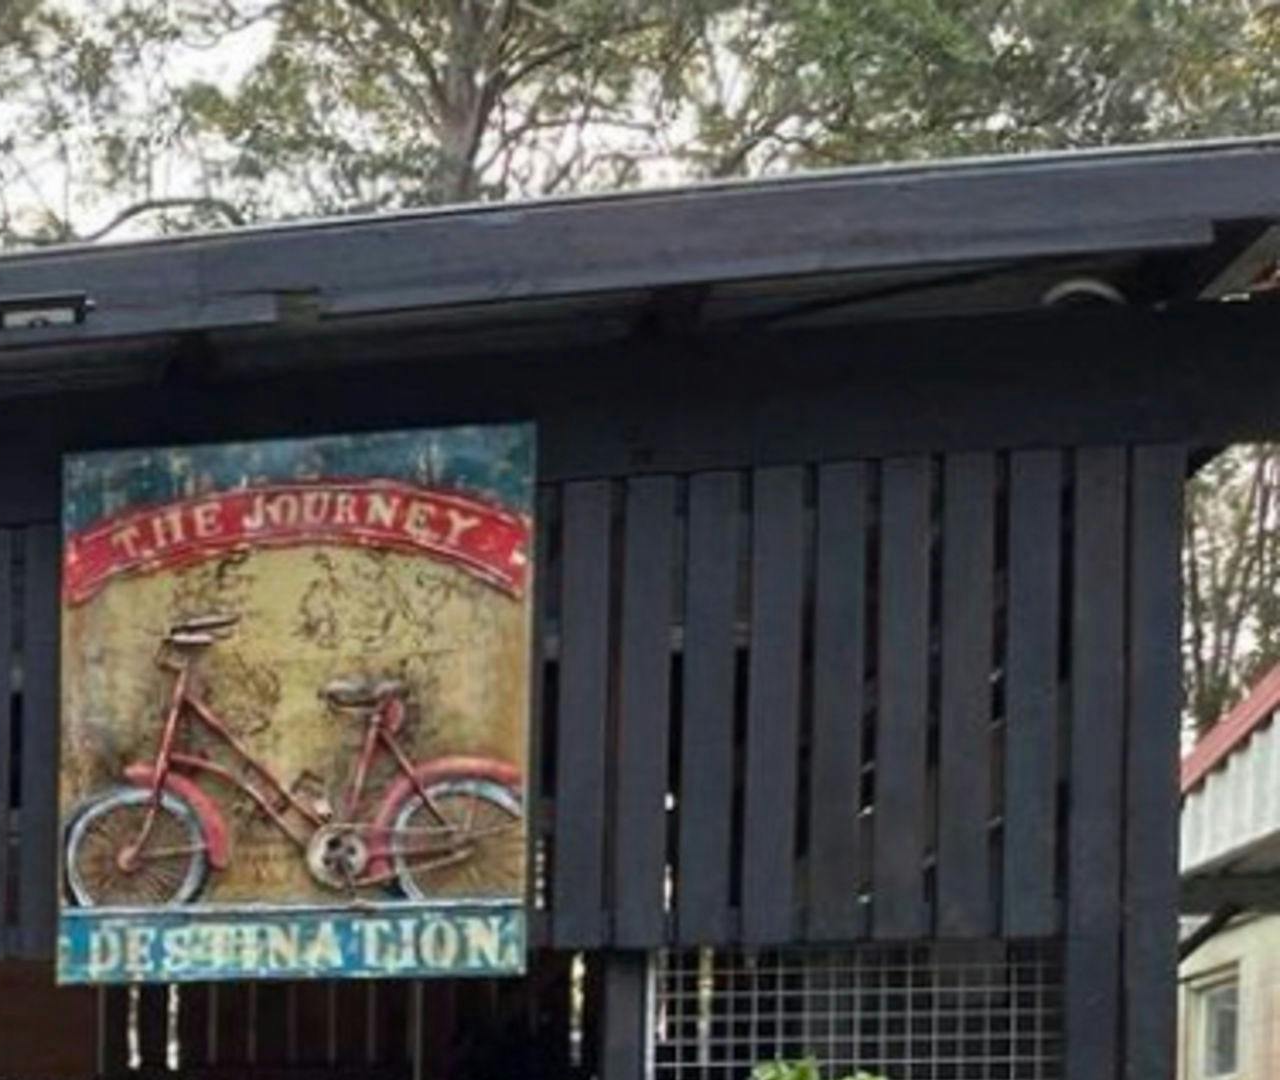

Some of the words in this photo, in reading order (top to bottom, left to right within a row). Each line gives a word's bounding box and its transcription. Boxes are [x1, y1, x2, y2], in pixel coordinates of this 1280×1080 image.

[111, 502, 224, 559] THE
[243, 490, 483, 547] JOURNEY
[89, 916, 504, 974] DESTINATION
